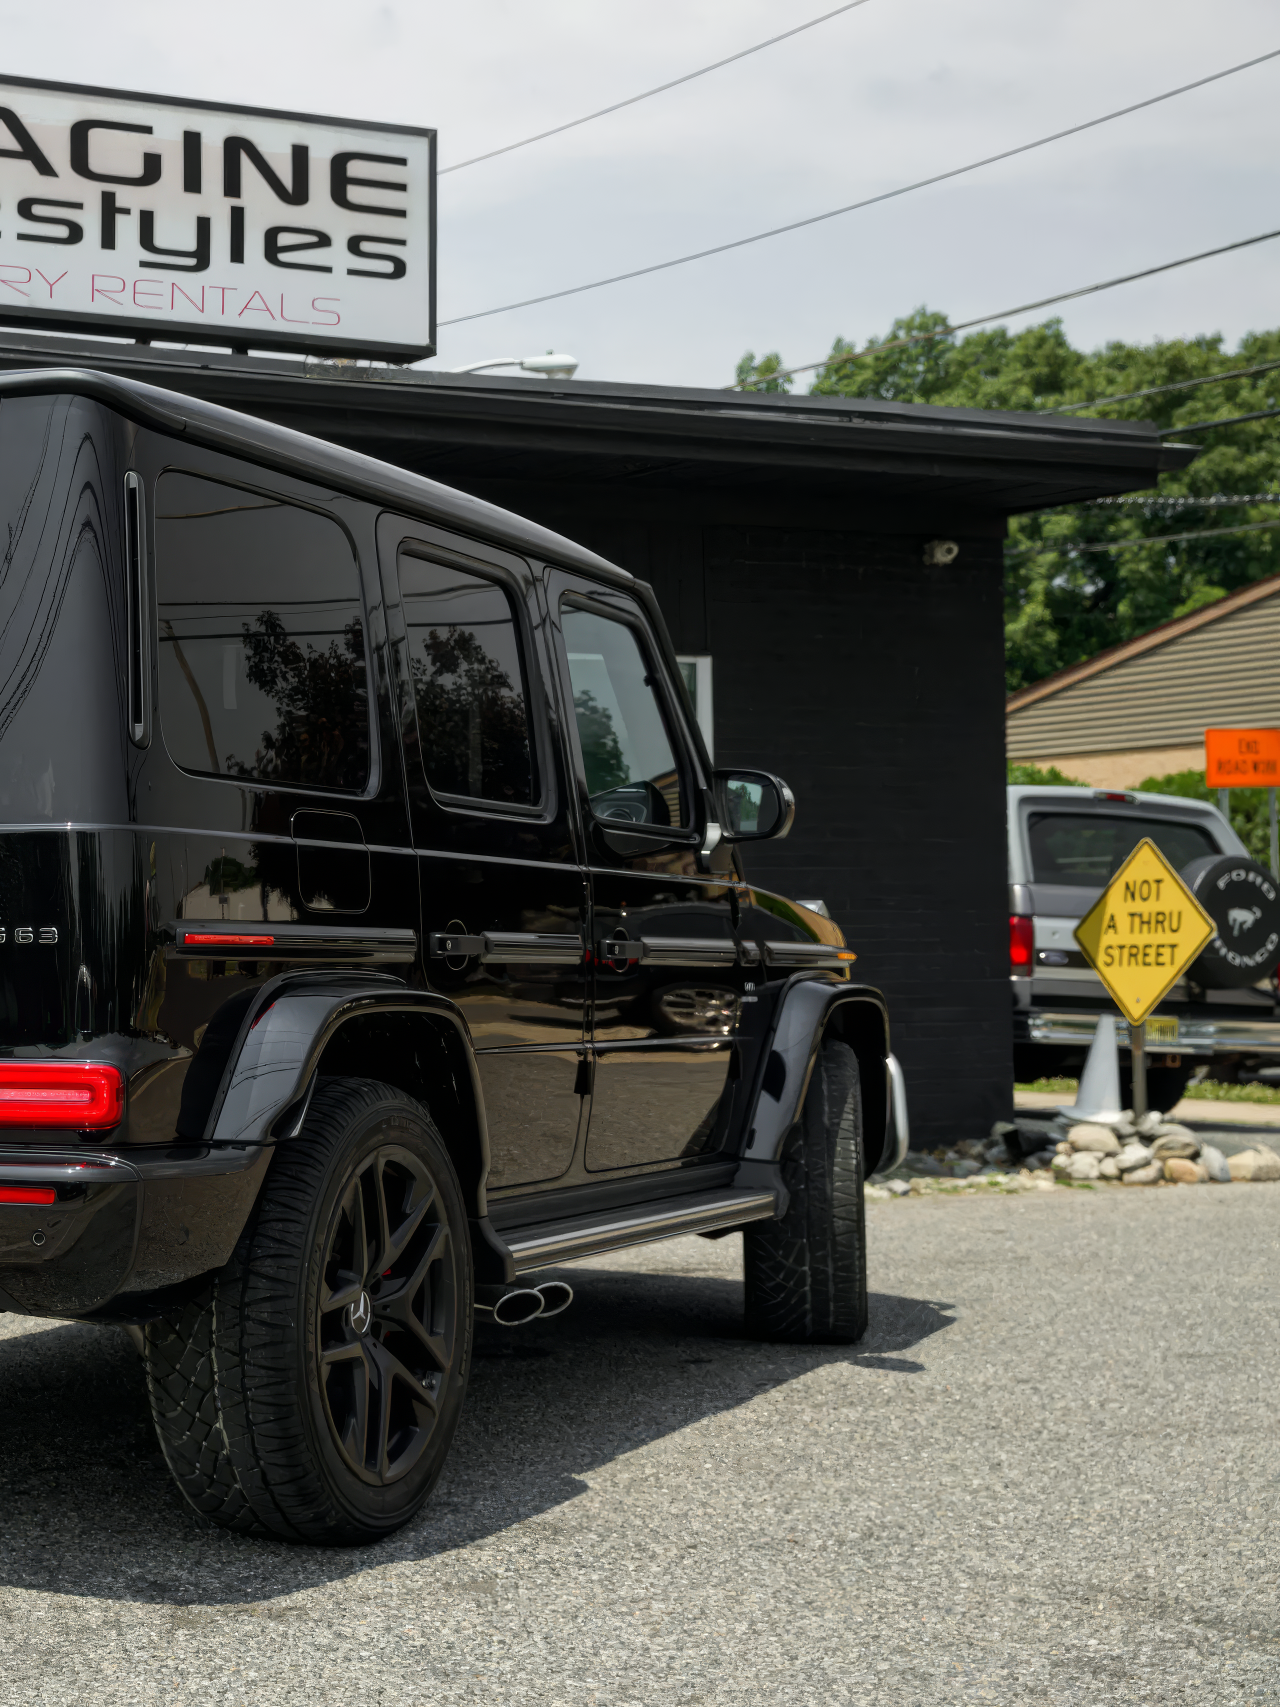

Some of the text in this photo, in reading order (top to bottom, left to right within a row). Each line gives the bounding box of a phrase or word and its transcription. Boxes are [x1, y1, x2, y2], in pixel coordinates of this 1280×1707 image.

[91, 274, 341, 326] RENTALS
[1124, 879, 1164, 903] NOT
[1217, 868, 1276, 901] FORD
[1104, 910, 1182, 935] A THRU
[14, 927, 58, 944] 63
[1103, 944, 1179, 968] STREET
